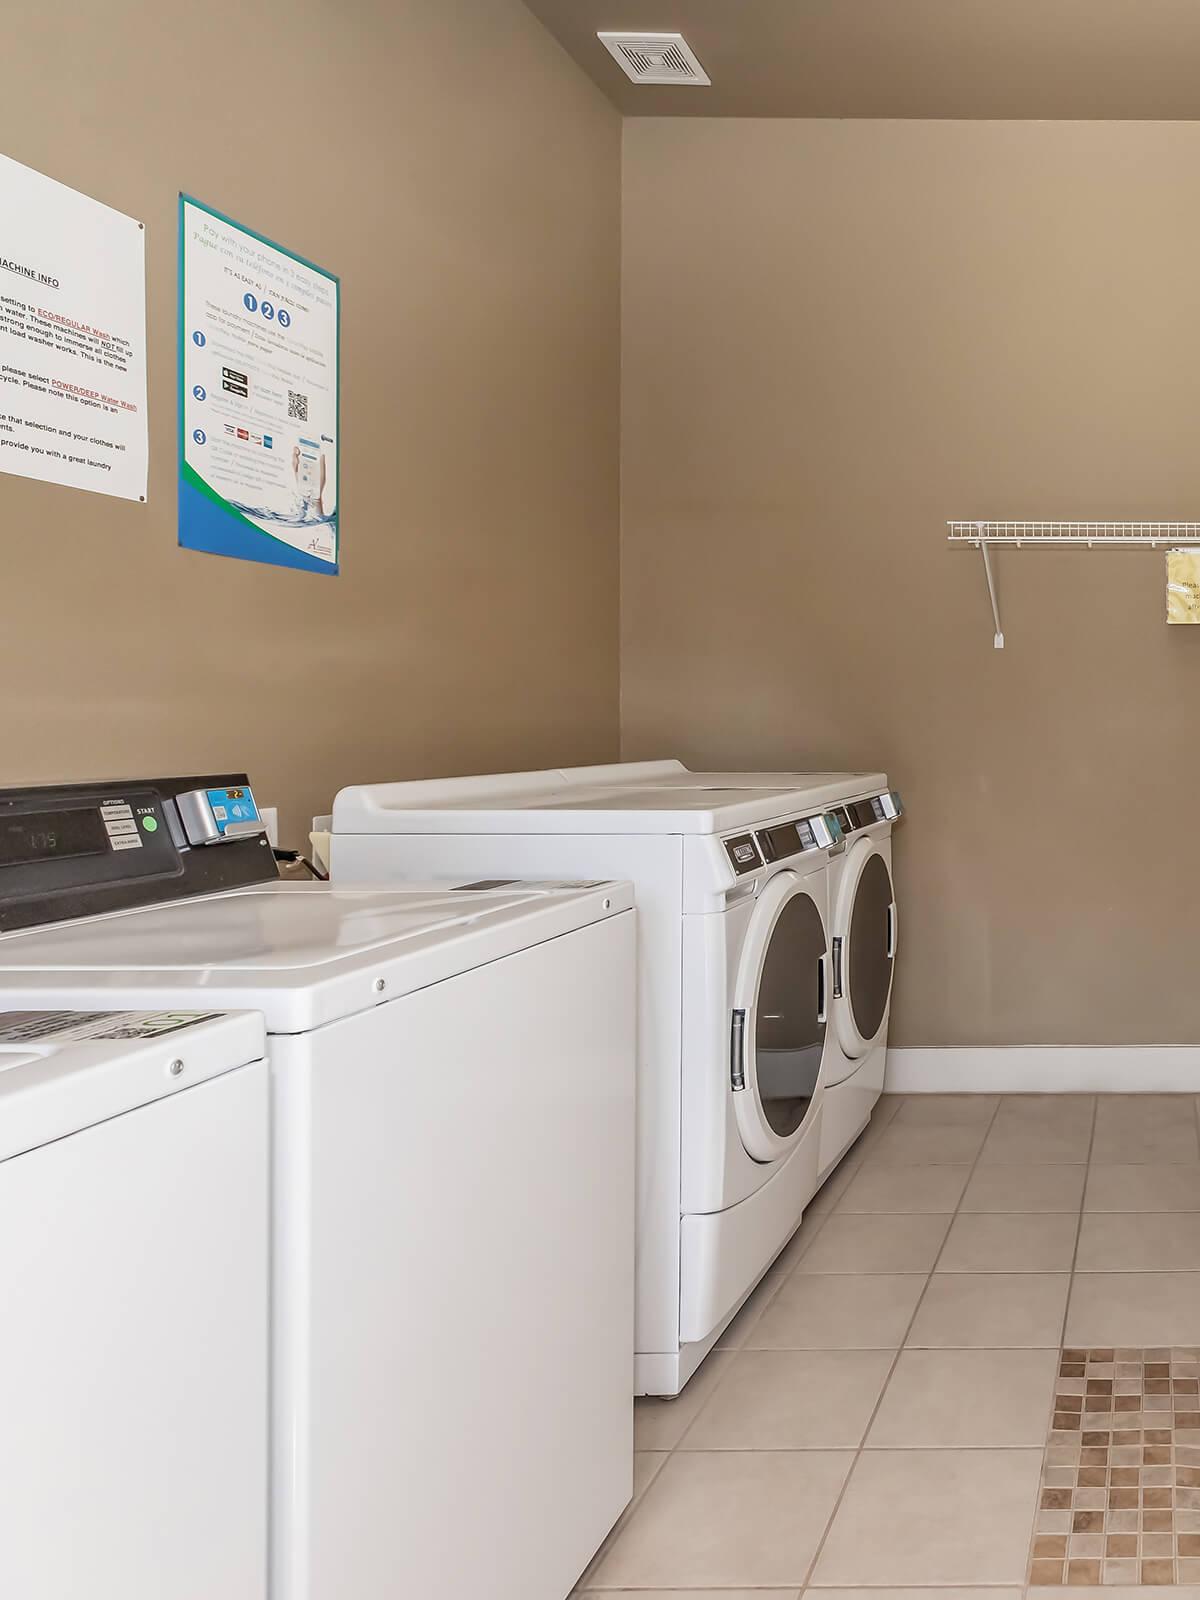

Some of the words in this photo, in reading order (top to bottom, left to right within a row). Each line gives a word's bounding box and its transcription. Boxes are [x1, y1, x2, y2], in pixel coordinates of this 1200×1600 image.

[192, 231, 219, 250] Pague
[220, 247, 234, 258] con
[203, 223, 219, 239] Pay
[221, 236, 238, 248] with
[257, 253, 281, 271] phone
[38, 273, 60, 289] INFO
[241, 274, 254, 286] EASY
[0, 296, 26, 310] setting
[28, 305, 35, 313] to
[37, 308, 91, 332] ECO/REGULAR
[92, 327, 111, 340] Wash
[111, 336, 130, 347] which
[0, 315, 24, 330] strong
[26, 323, 54, 339] enough
[55, 332, 62, 341] to
[64, 336, 93, 352] immerse
[94, 346, 102, 355] all
[104, 350, 126, 364] clothes
[5, 308, 28, 320] water.
[30, 315, 52, 328] These
[53, 323, 87, 340] machines
[88, 336, 100, 345] will
[100, 340, 116, 351] NOT
[116, 345, 124, 354] fill
[125, 350, 133, 358] up
[10, 327, 26, 339] load
[27, 334, 54, 348] washer
[55, 344, 78, 356] works.
[80, 351, 94, 362] This
[96, 356, 102, 364] is
[103, 359, 113, 368] the
[115, 364, 127, 372] new
[2, 365, 26, 378] please
[28, 373, 50, 384] select
[51, 379, 99, 398] POWER/DEEP
[101, 393, 119, 405] Water
[120, 400, 137, 411] Wash
[23, 379, 47, 392] Please
[48, 388, 64, 398] note
[65, 393, 79, 402] this
[80, 397, 101, 410] option
[8, 415, 23, 425] that
[25, 420, 57, 434] selection
[58, 428, 72, 438] and
[73, 432, 88, 442] your
[90, 437, 113, 449] clothes
[115, 443, 126, 451] will
[0, 439, 29, 452] provide
[31, 445, 44, 455] you
[46, 449, 61, 459] with
[68, 454, 86, 466] great
[87, 459, 112, 472] laundry
[136, 807, 155, 815] START
